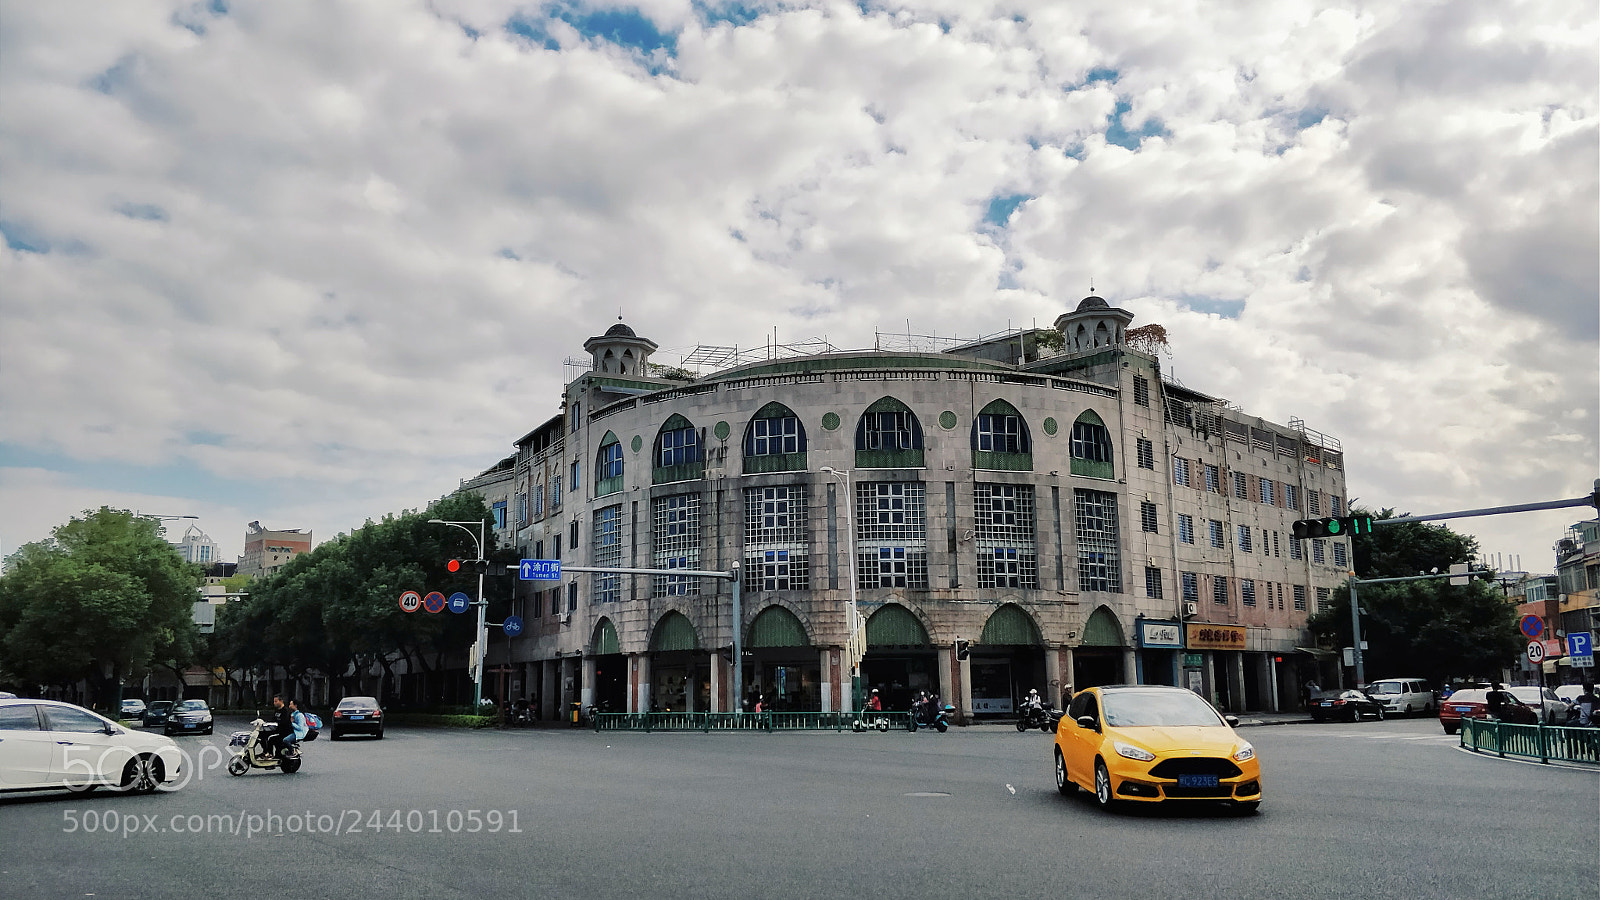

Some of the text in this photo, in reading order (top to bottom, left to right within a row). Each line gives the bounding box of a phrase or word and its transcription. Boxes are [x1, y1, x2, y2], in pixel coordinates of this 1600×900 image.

[532, 562, 559, 573] 涂门街
[403, 596, 417, 607] 40
[1571, 635, 1587, 654] P
[1528, 645, 1542, 658] 20
